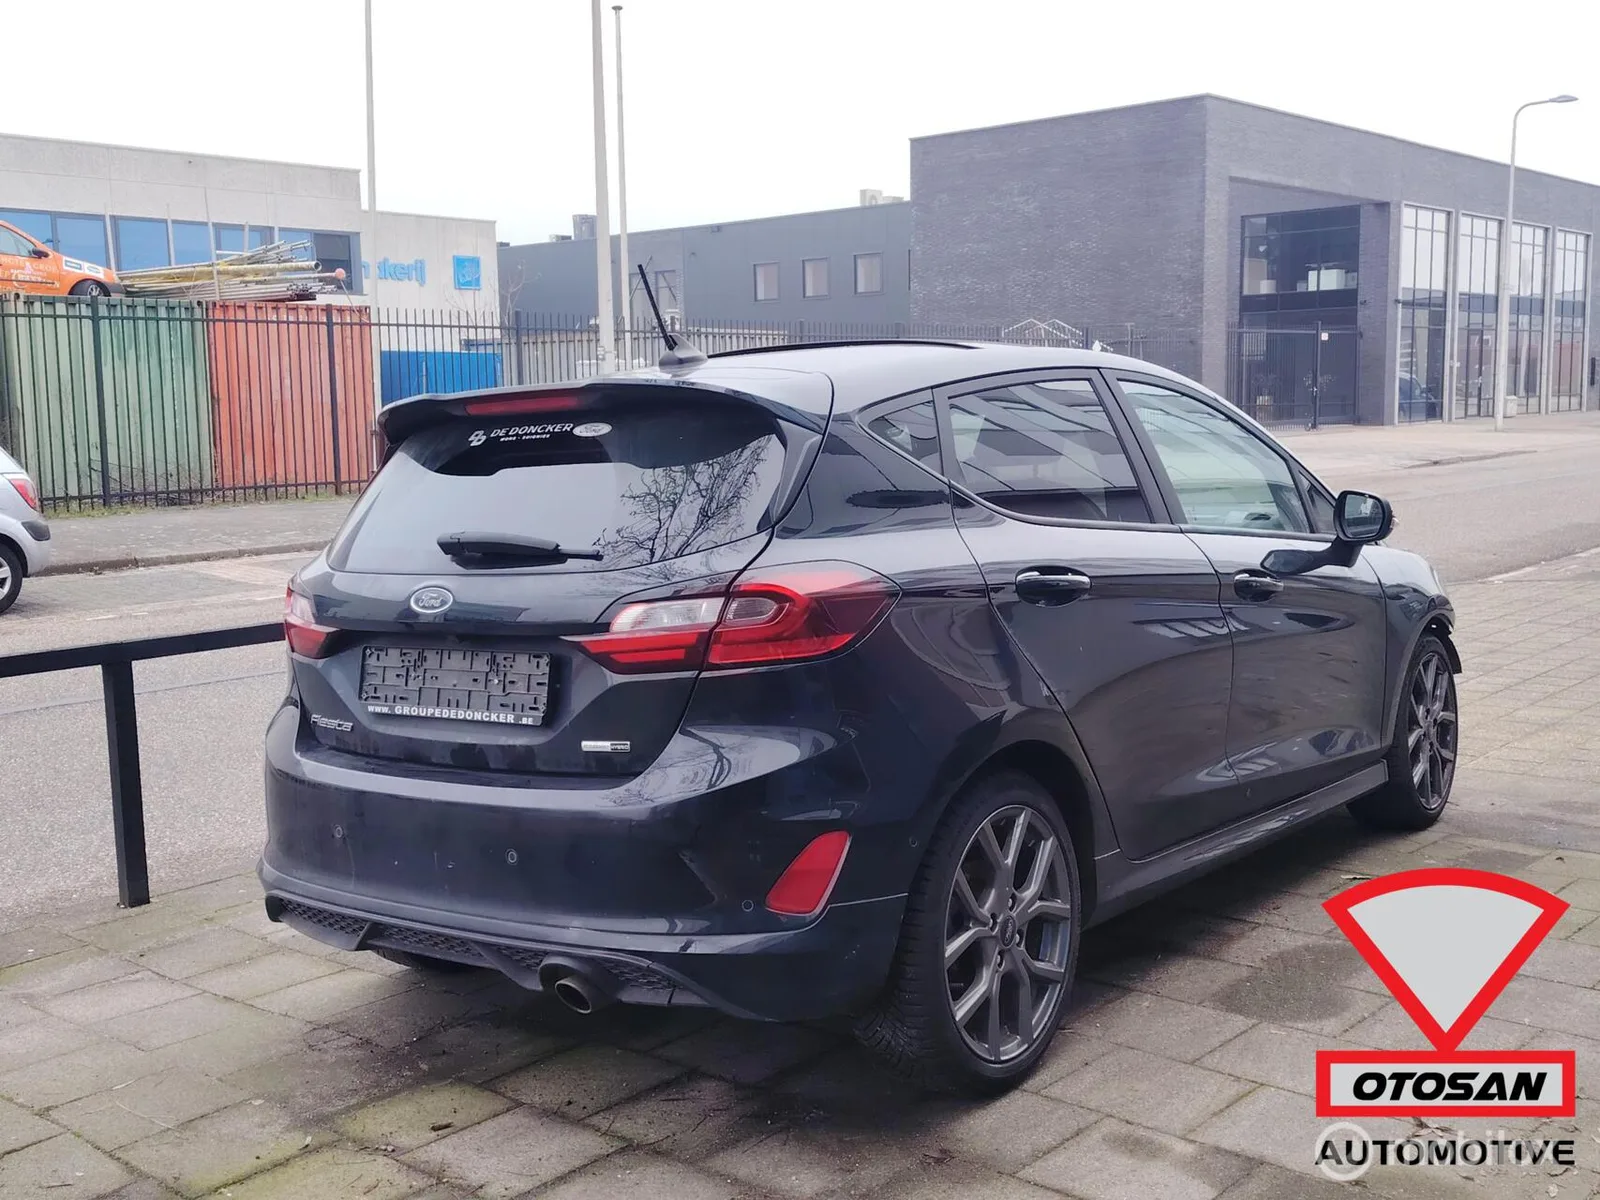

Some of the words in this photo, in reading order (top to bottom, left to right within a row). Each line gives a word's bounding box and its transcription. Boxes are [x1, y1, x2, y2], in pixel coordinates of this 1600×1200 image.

[490, 427, 509, 437] DE
[508, 423, 574, 435] DONCKER
[418, 591, 444, 608] Ford
[394, 702, 515, 724] GROUPEDEDONCKER
[310, 713, 354, 732] Fiesta
